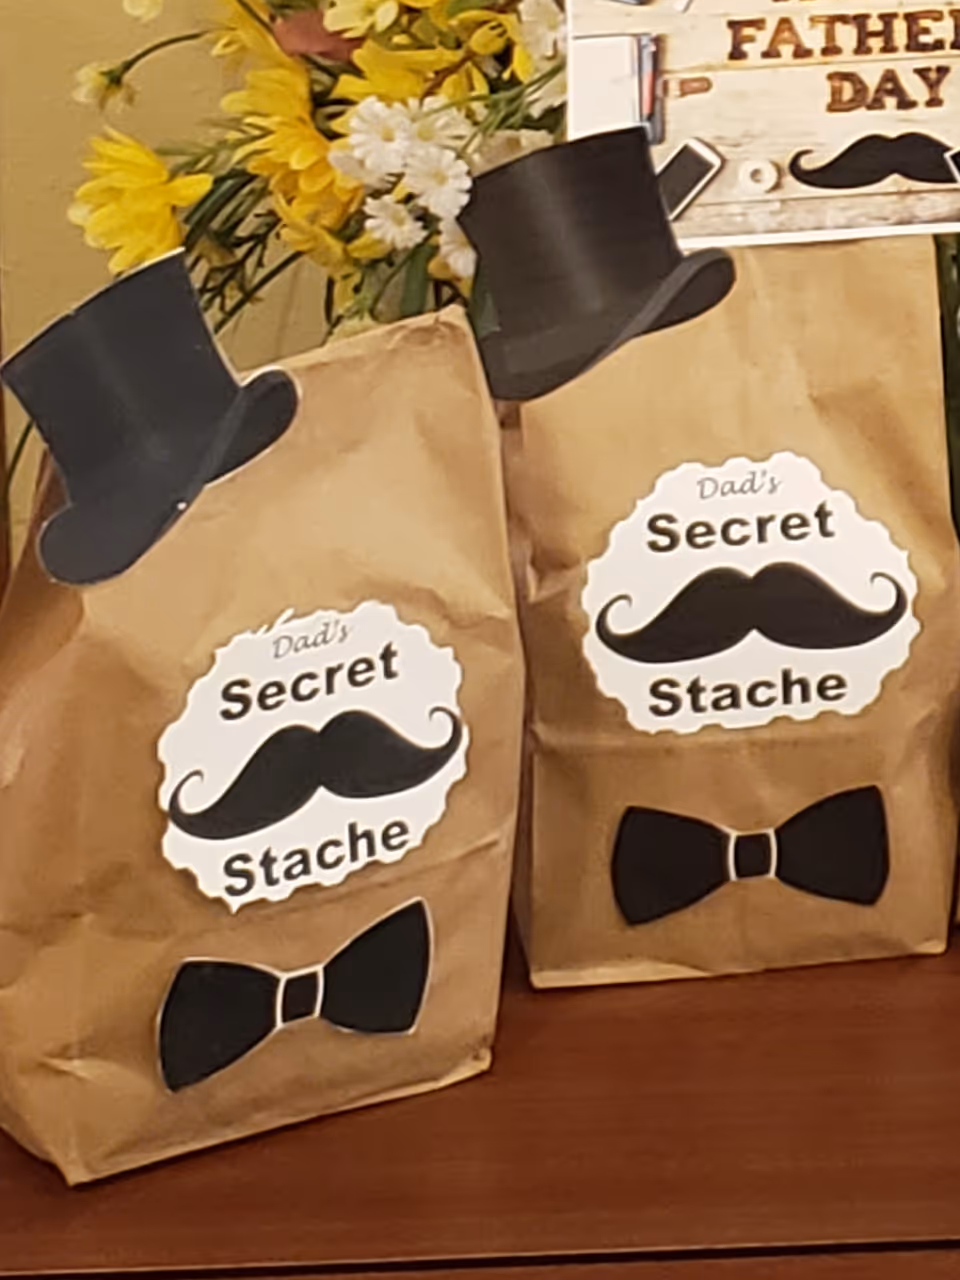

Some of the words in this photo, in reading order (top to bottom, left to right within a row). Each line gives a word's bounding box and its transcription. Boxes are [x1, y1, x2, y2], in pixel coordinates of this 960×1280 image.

[826, 66, 951, 113] DAY
[697, 470, 782, 499] Dad's
[647, 501, 835, 552] Secret
[272, 620, 352, 659] Dad's
[219, 641, 398, 720] Secret
[649, 669, 847, 717] Stache
[223, 820, 409, 897] Stache
